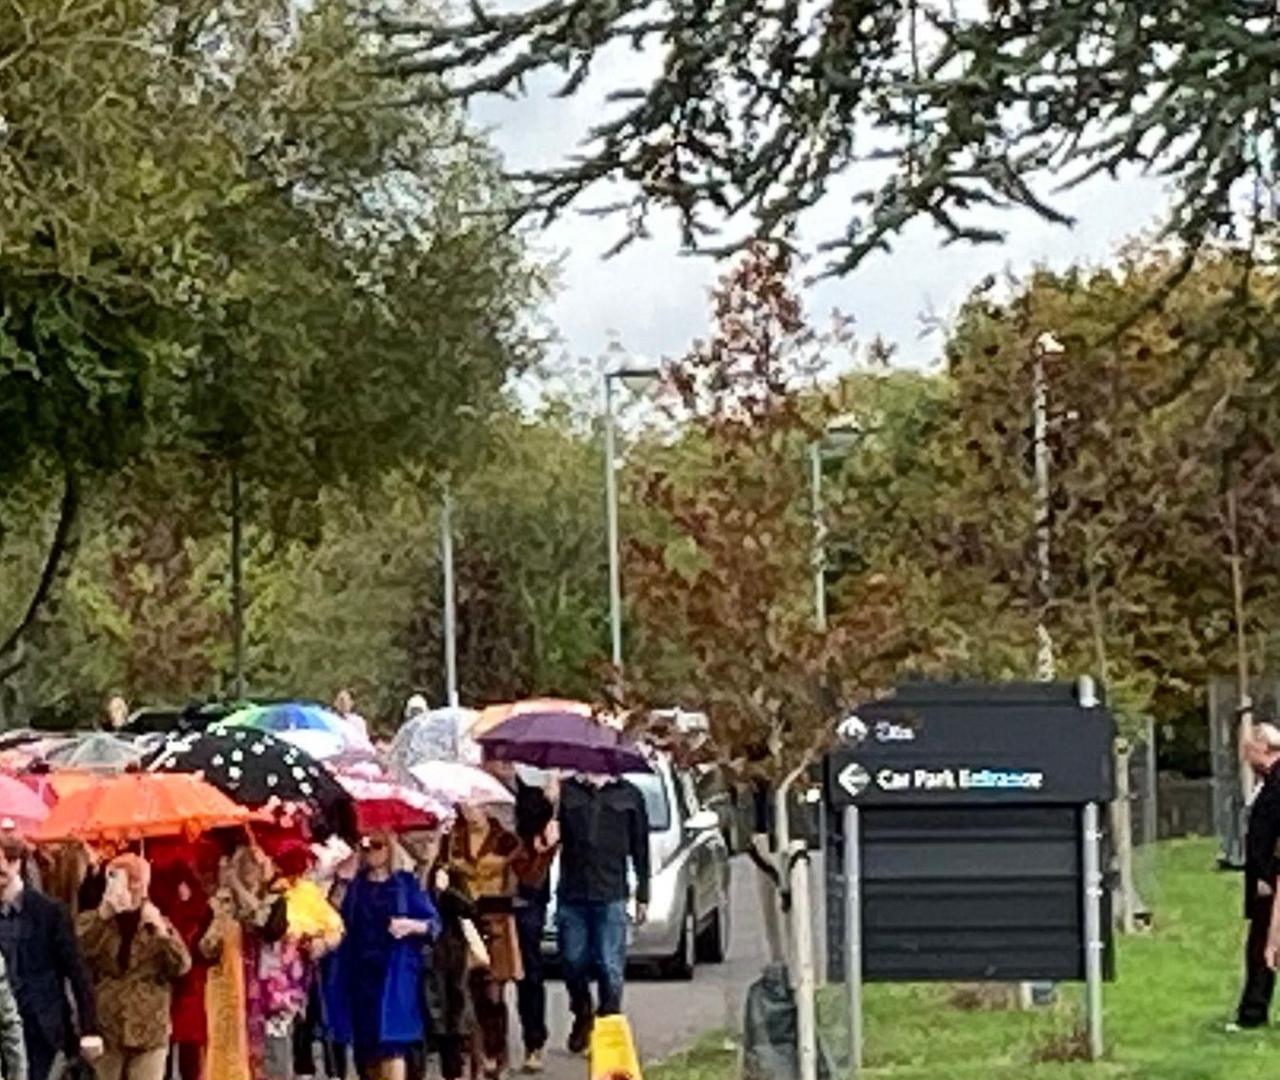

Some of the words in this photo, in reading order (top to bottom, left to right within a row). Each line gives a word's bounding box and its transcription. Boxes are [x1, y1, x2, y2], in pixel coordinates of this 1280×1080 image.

[877, 769, 910, 790] Car
[914, 769, 956, 790] Park
[959, 769, 1044, 790] Entrance
